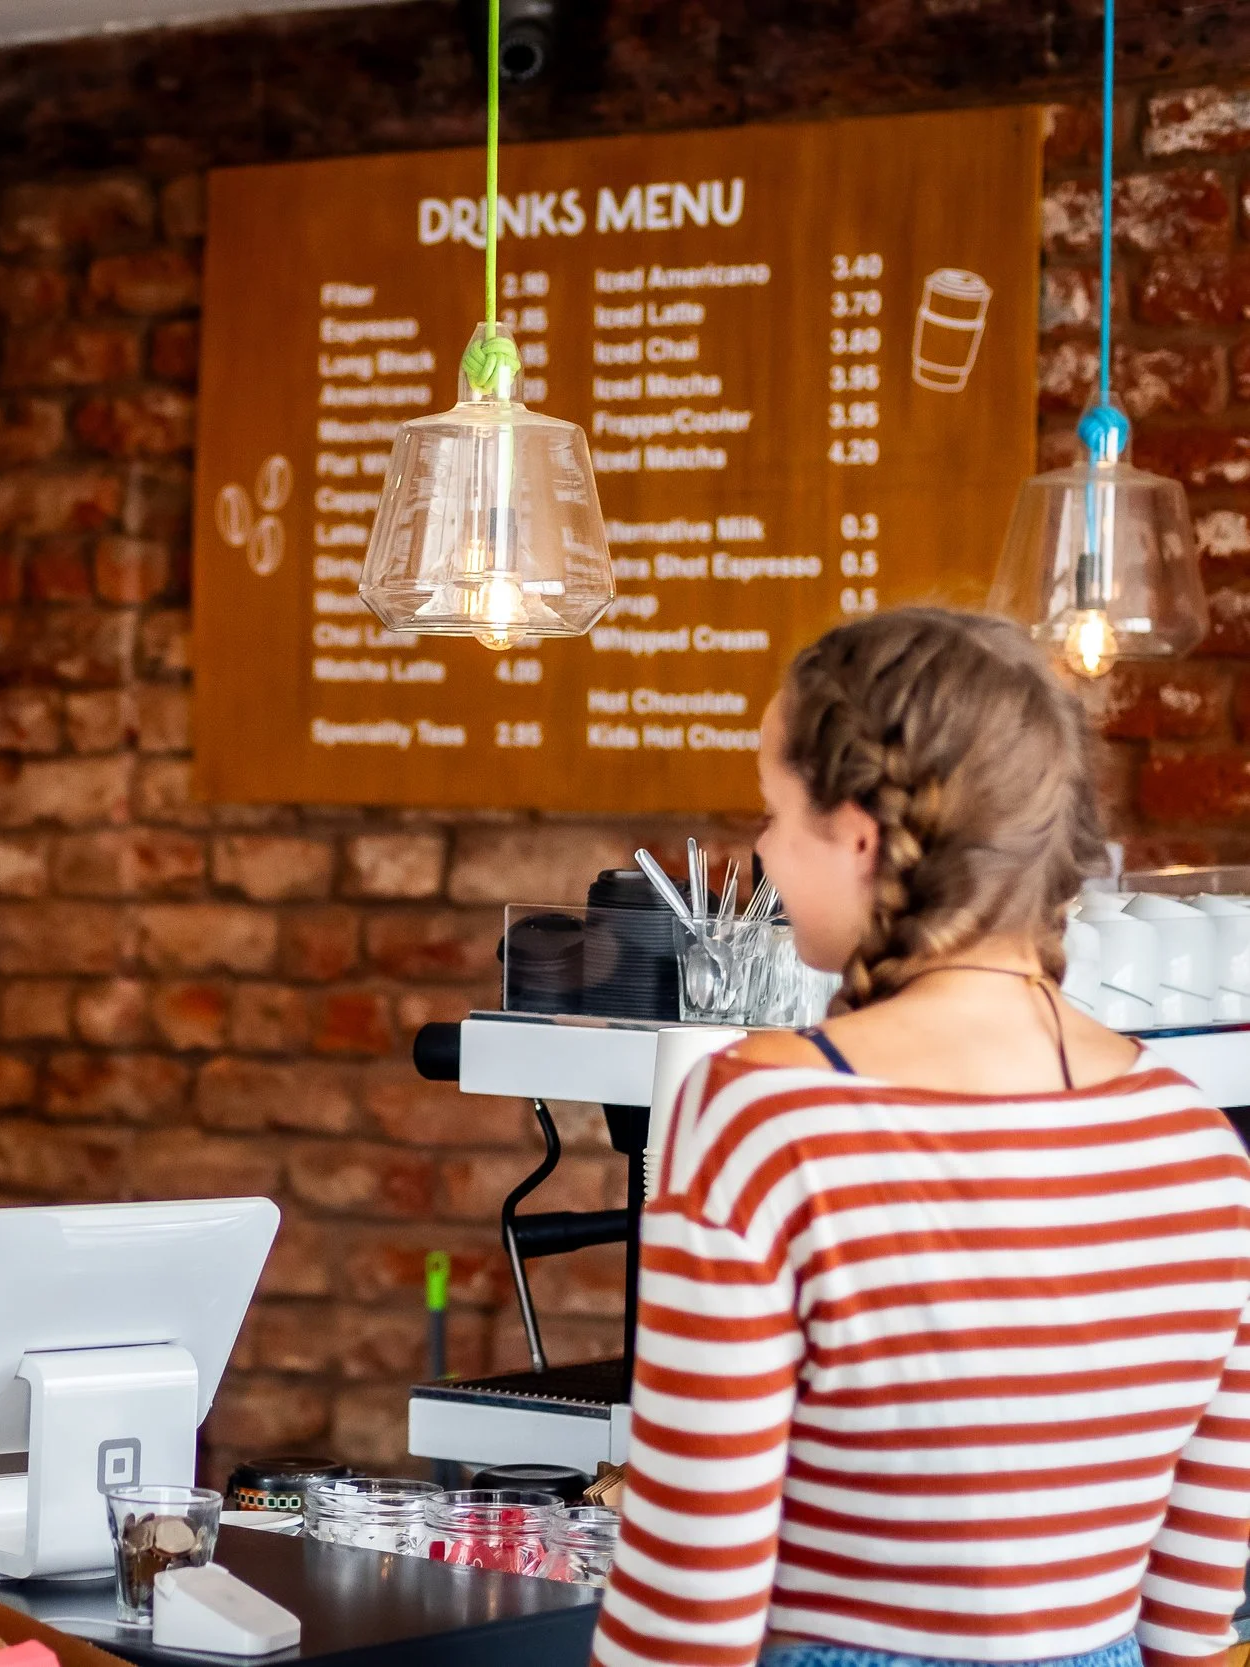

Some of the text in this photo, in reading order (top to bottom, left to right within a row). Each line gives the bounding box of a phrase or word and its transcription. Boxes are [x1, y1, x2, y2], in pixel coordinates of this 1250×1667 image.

[418, 180, 742, 249] DRINKS MENU
[597, 255, 882, 291] Iced Americano 3.40
[596, 291, 880, 327] Iced Latte 3.70
[322, 320, 416, 342] Espresso
[595, 342, 642, 363] Iced
[647, 339, 697, 360] Chai
[321, 352, 433, 378] Long Black
[322, 387, 430, 405] Americano
[595, 378, 641, 399] Iced
[647, 375, 720, 396] Mocha
[318, 455, 356, 475] Flat
[593, 440, 878, 470] Iced Matcha 4.20
[718, 518, 762, 539] Milk
[842, 515, 877, 538] 0.3
[655, 555, 707, 578] Shot
[713, 554, 820, 580] Espresso
[842, 552, 877, 575] 0.5
[315, 625, 361, 645] Chai
[590, 626, 768, 655] Whipped Cream
[315, 660, 389, 680] Matcha
[393, 662, 444, 680] Latte
[589, 690, 745, 713] Hot Chocolate
[418, 722, 464, 744] Teas
[589, 726, 638, 747] Kids
[644, 727, 683, 747] Hot
